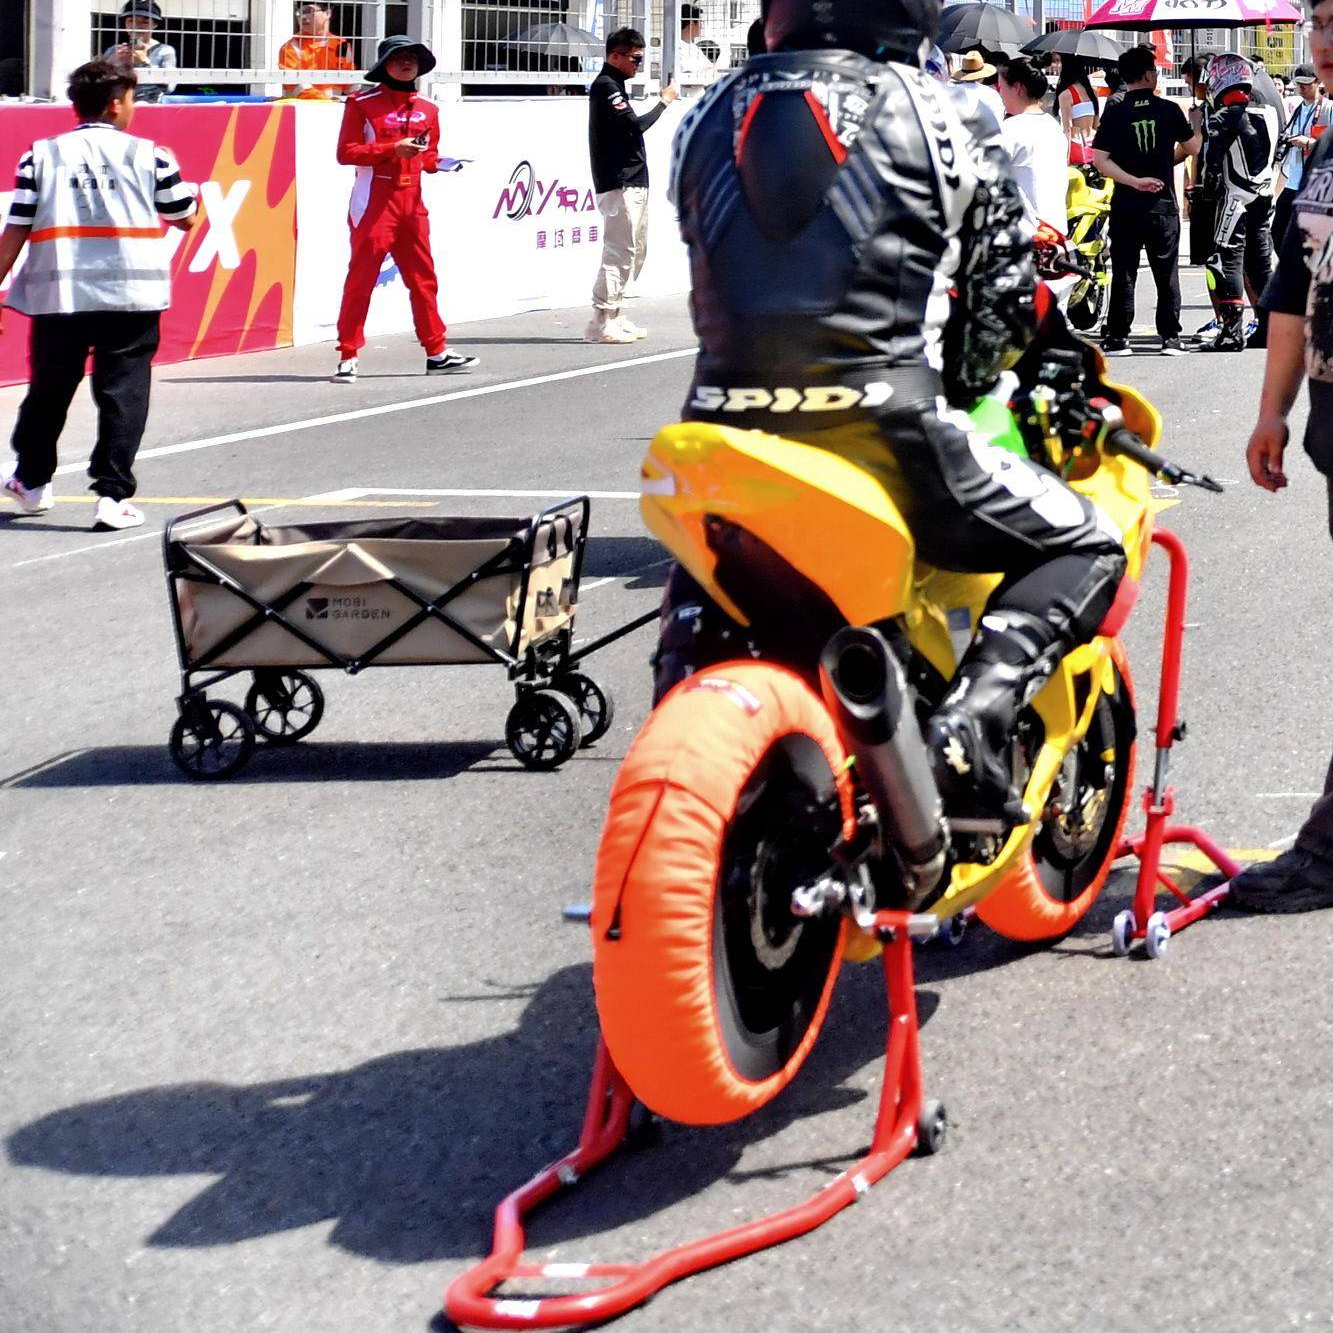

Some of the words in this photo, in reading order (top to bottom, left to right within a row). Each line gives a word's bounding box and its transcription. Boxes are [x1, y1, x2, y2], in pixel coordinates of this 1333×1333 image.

[690, 382, 894, 413] SPIDI
[332, 597, 366, 607] MOBI
[332, 609, 390, 619] GARDEN
